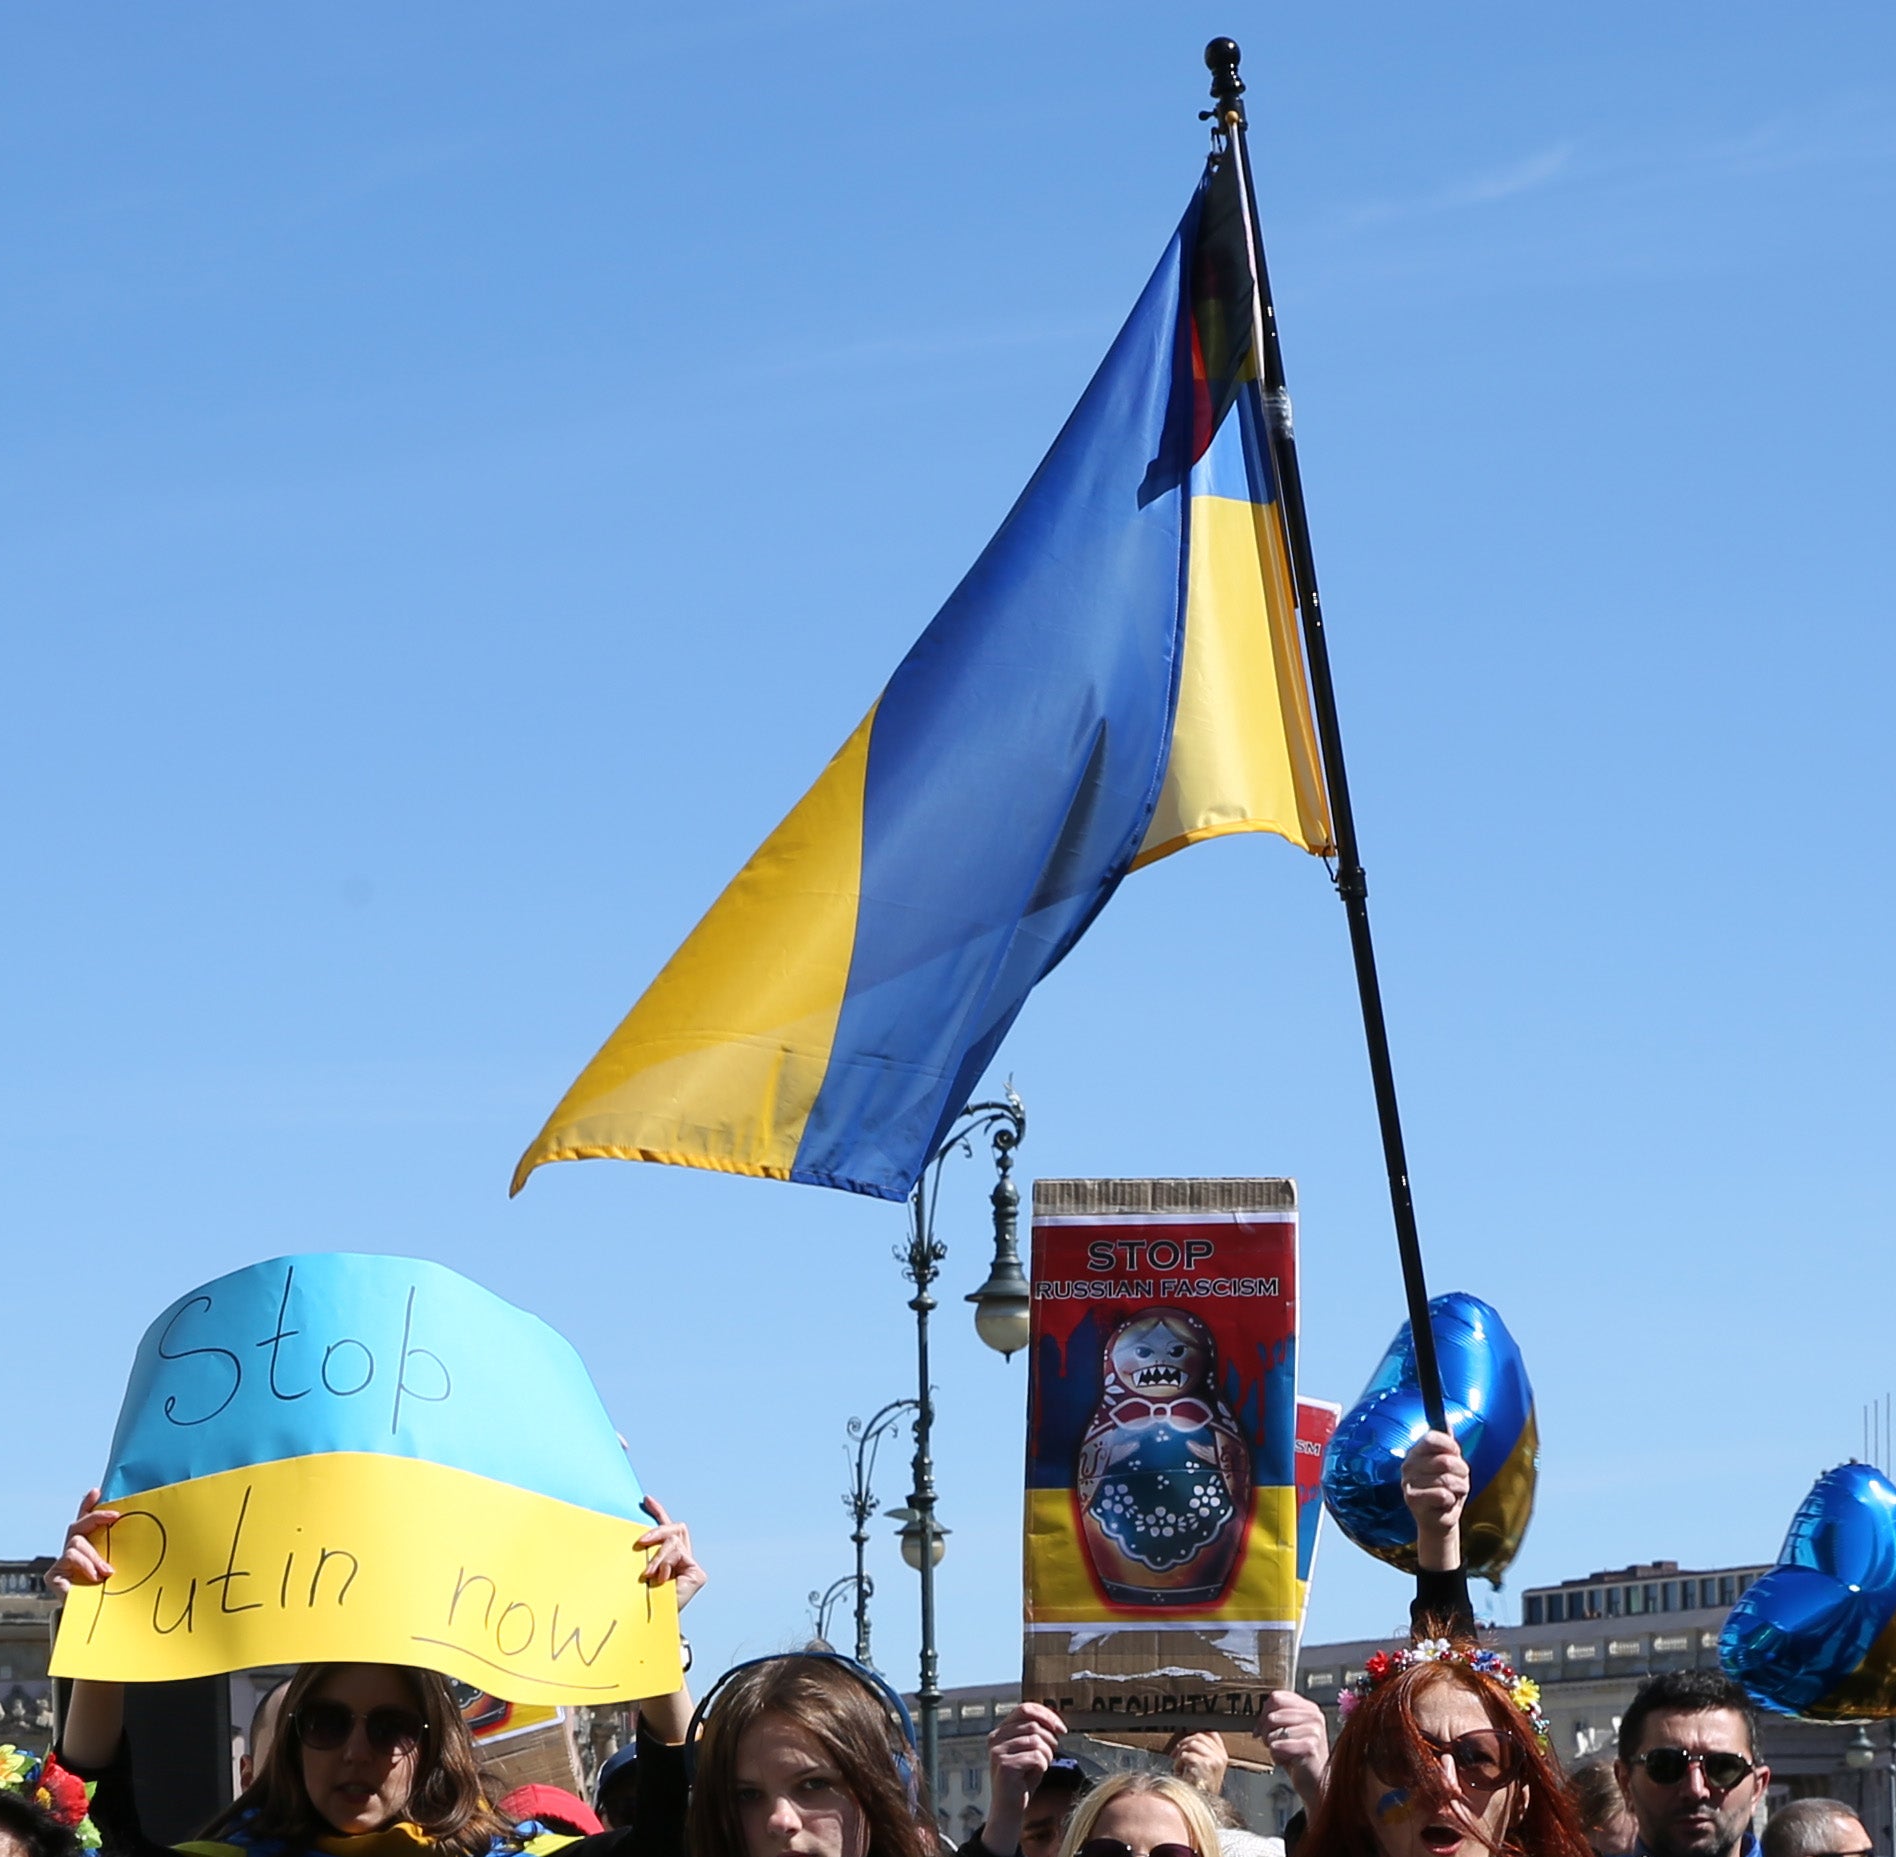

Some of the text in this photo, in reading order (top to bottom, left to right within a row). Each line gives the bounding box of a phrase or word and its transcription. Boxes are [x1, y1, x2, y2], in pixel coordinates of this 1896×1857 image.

[1034, 1277, 1279, 1300] RUSSIAN FASCISM
[1087, 1239, 1214, 1271] STOP
[157, 1264, 451, 1434] Stop
[87, 1484, 359, 1645] Putin
